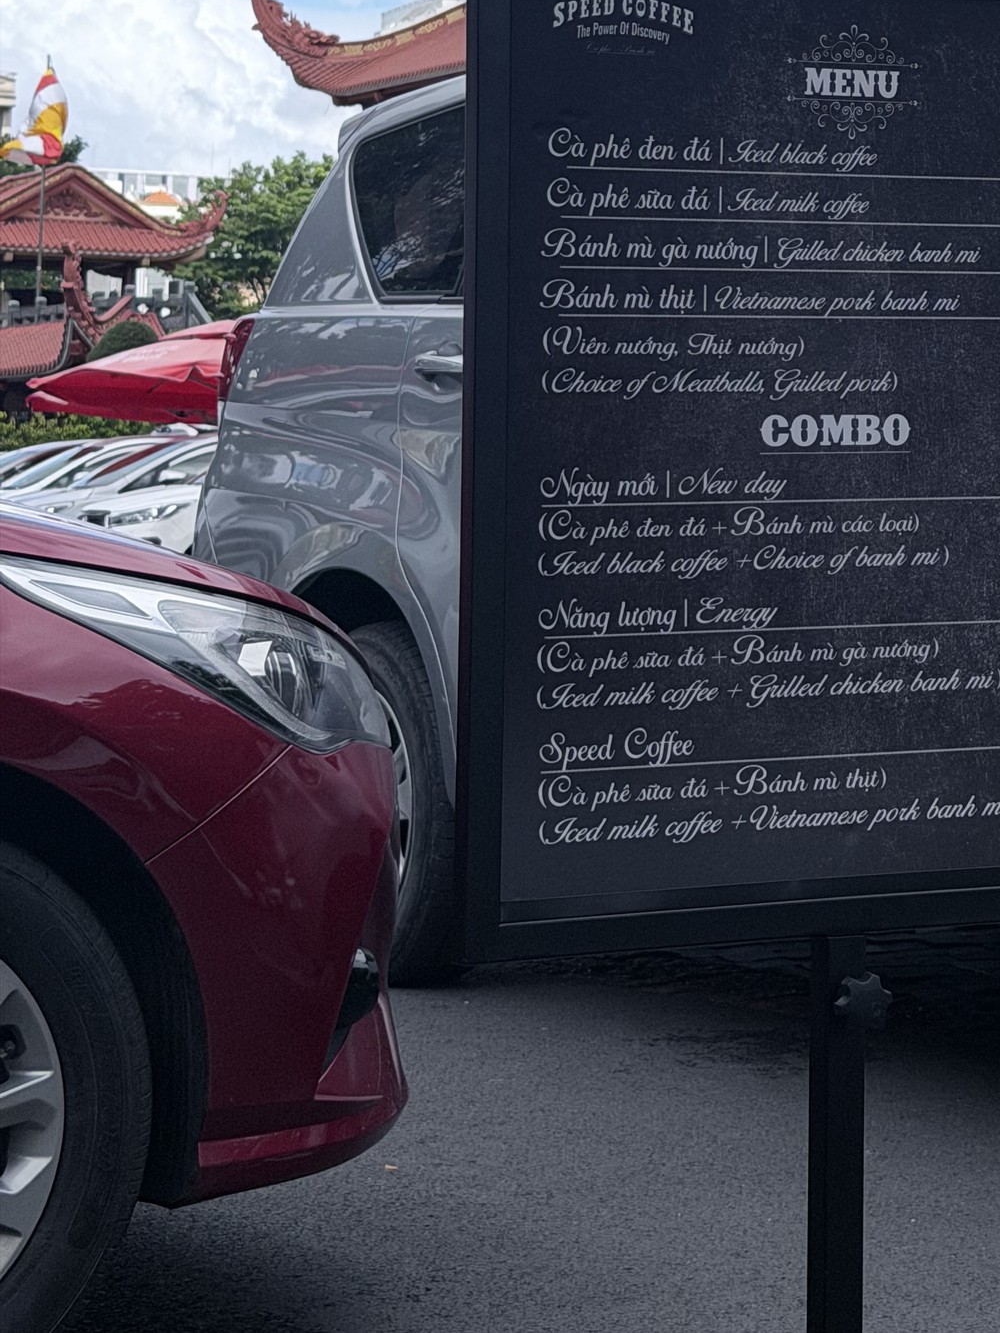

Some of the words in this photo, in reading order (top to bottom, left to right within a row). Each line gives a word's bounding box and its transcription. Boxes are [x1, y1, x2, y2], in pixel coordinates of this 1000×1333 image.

[577, 24, 591, 39] The
[593, 22, 618, 36] Power
[619, 21, 629, 35] Of
[632, 22, 670, 45] Discovery
[804, 67, 900, 98] MENU
[548, 127, 587, 158] Cà
[590, 133, 632, 167] phê
[638, 135, 677, 160] đen
[683, 137, 713, 162] đá
[728, 139, 779, 164] Iced
[779, 143, 828, 165] black
[831, 145, 878, 172] coffee
[547, 177, 586, 208] Cà
[589, 183, 631, 217] phê
[634, 188, 675, 210] sữa
[681, 186, 711, 211] đá
[727, 188, 778, 212] Iced
[776, 192, 820, 213] milk
[822, 193, 870, 220] coffee
[541, 228, 621, 258] Bánh
[626, 236, 656, 259] mì
[658, 237, 691, 267] gà
[695, 238, 758, 268] nướng
[842, 241, 905, 262] chicken
[908, 242, 953, 263] banh
[954, 246, 982, 263] mi
[539, 278, 618, 308] Bánh
[623, 286, 654, 309] mì
[659, 284, 696, 314] thịt
[715, 285, 826, 310] Vietnamese
[824, 289, 876, 316] pork
[880, 290, 930, 311] banh
[932, 294, 960, 311] mi
[687, 333, 734, 359] Thịt
[623, 371, 656, 400] of
[760, 413, 911, 447] COMBO
[540, 467, 609, 505] Ngày
[617, 472, 659, 496] mới
[678, 467, 738, 495] New
[744, 471, 787, 500] day
[589, 518, 631, 546] phê
[636, 517, 673, 538] đen
[679, 516, 708, 537] đá
[809, 515, 836, 534] mì
[841, 514, 875, 534] các
[606, 550, 666, 575] black
[670, 549, 729, 580] coffee
[827, 545, 859, 575] of
[855, 545, 907, 567] banh
[538, 598, 610, 636] Năng
[618, 601, 677, 634] lượng
[695, 597, 778, 630] Energy
[588, 649, 630, 678] phê
[633, 651, 672, 669] sữa
[677, 646, 706, 667] đá
[809, 642, 837, 662] mì
[839, 640, 868, 667] gà
[603, 681, 656, 707] milk
[661, 679, 720, 711] coffee
[829, 672, 905, 696] chicken
[910, 668, 961, 693] banh
[539, 732, 616, 771] Speed
[624, 727, 695, 767] Coffee
[590, 782, 631, 812] phê
[635, 783, 675, 802] sữa
[680, 777, 709, 799] đá
[813, 771, 841, 792] mì
[606, 814, 660, 841] milk
[665, 810, 723, 844] coffee
[866, 798, 921, 831] pork
[926, 795, 978, 820] banh
